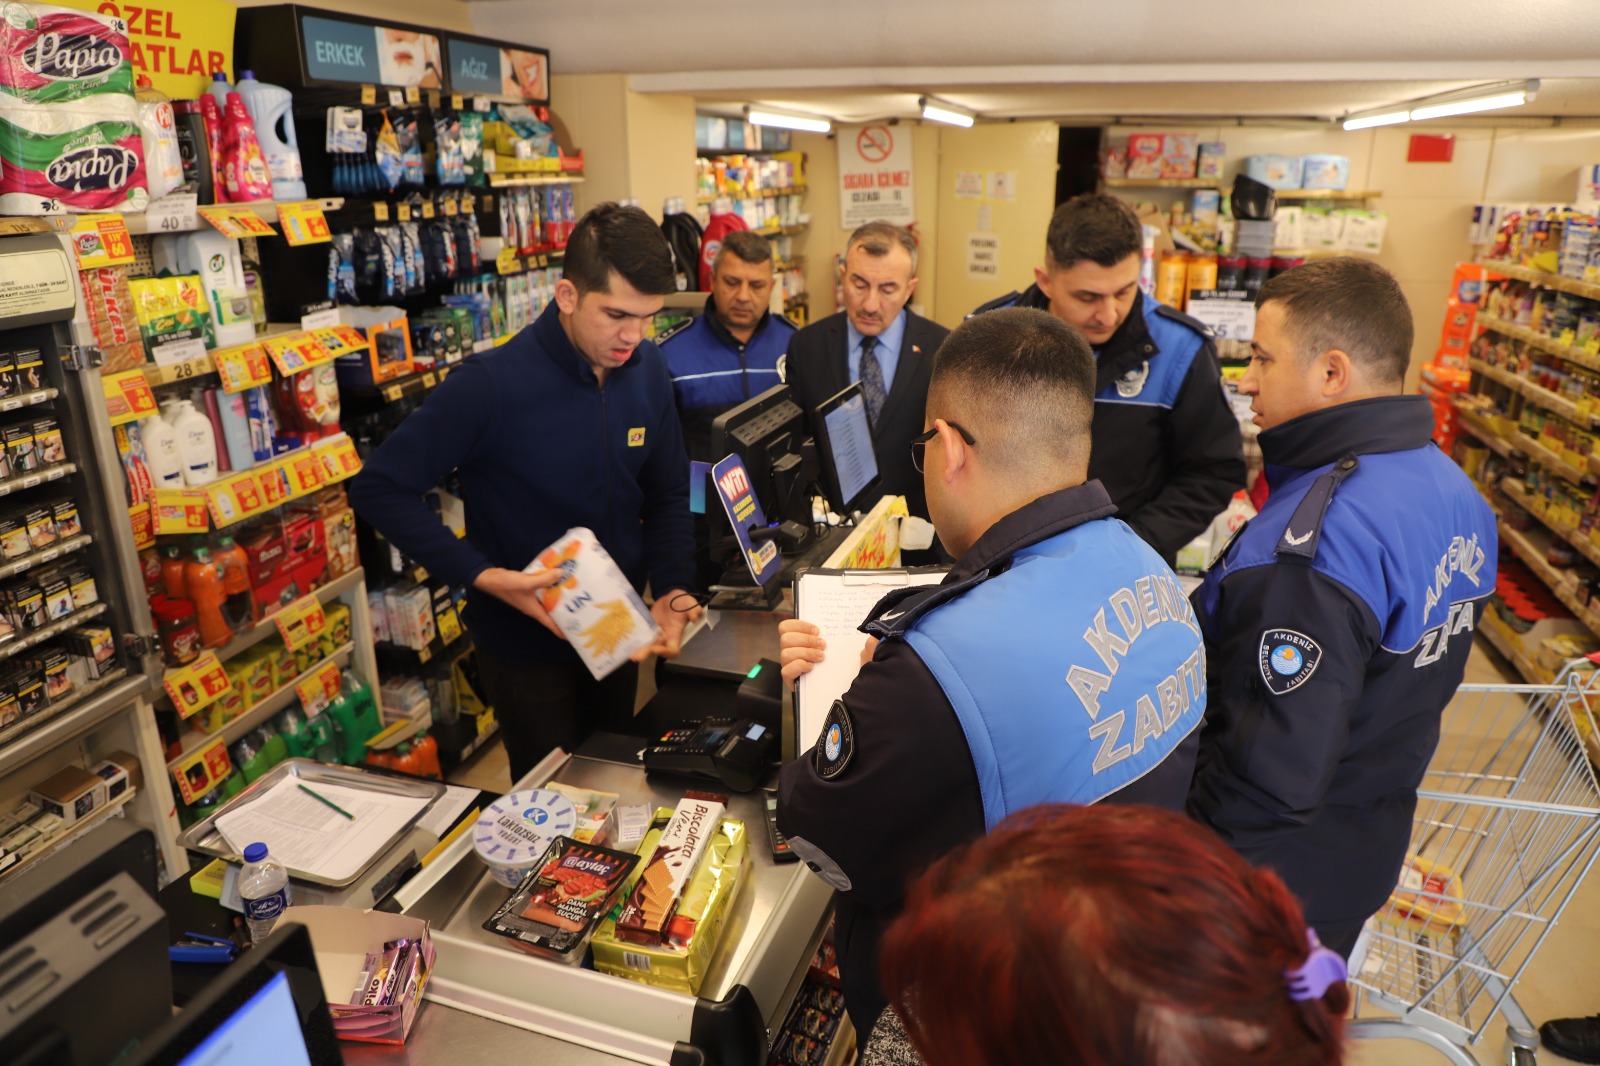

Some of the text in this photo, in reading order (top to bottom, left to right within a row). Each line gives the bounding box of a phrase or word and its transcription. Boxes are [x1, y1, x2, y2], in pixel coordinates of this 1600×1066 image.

[34, 32, 118, 79] Papia
[314, 40, 366, 67] ERKEK
[460, 58, 489, 80] AĞIZ
[51, 146, 130, 192] Papia
[161, 217, 179, 230] 40
[97, 266, 128, 346] ÜLKER
[174, 363, 193, 378] 28
[719, 466, 750, 503] Win
[1065, 567, 1200, 723] AKDENİZ
[1274, 632, 1314, 652] AKDENİZ
[496, 815, 542, 844] Laktozsuz
[681, 803, 709, 858] Biscolata
[556, 909, 582, 922] SUCUK
[557, 902, 588, 917] MANGAL
[566, 898, 588, 909] DANA
[364, 979, 380, 1006] Piko
